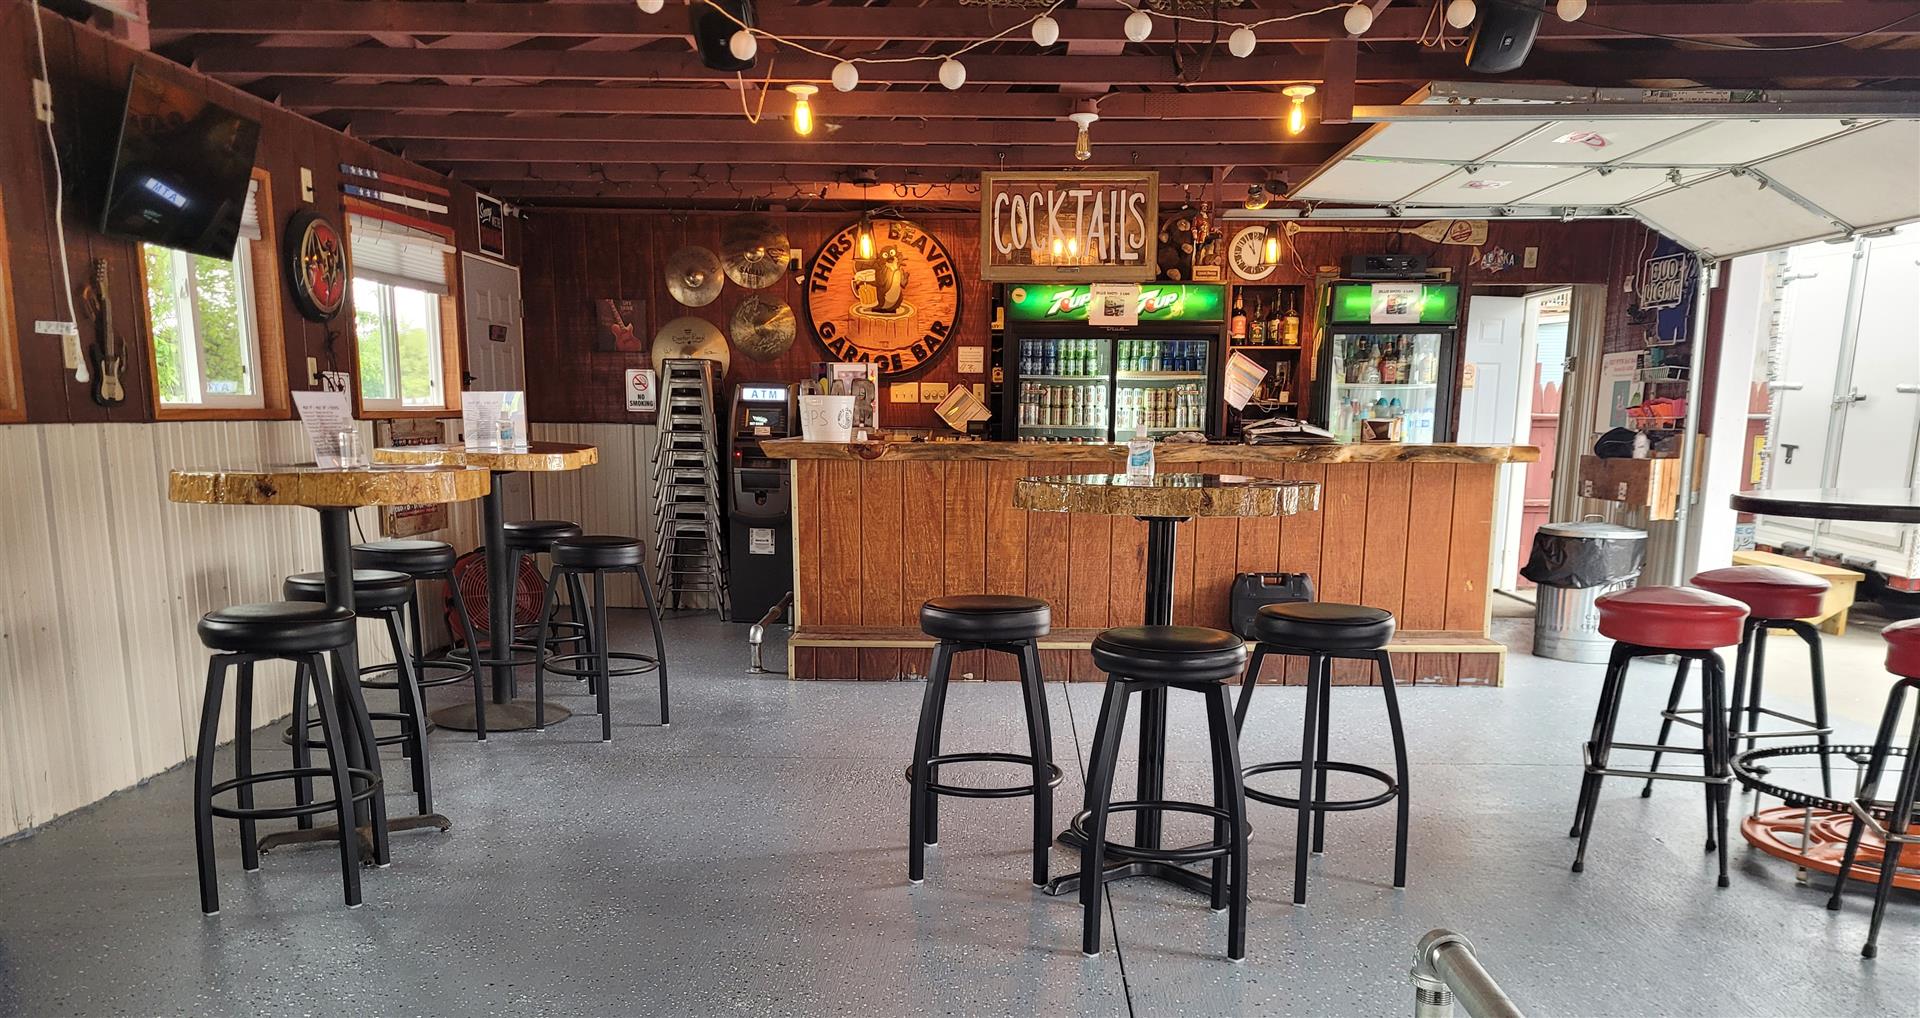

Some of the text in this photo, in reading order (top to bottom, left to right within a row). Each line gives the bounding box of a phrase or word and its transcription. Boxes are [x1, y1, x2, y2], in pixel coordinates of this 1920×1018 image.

[994, 189, 1145, 260] COCKTAILS
[811, 222, 954, 294] THIRST BEAVER
[1651, 259, 1678, 282] BUD
[1138, 288, 1179, 315] 7UP
[819, 321, 903, 371] GARAGE
[911, 320, 950, 362] BAR
[751, 390, 777, 399] ATM
